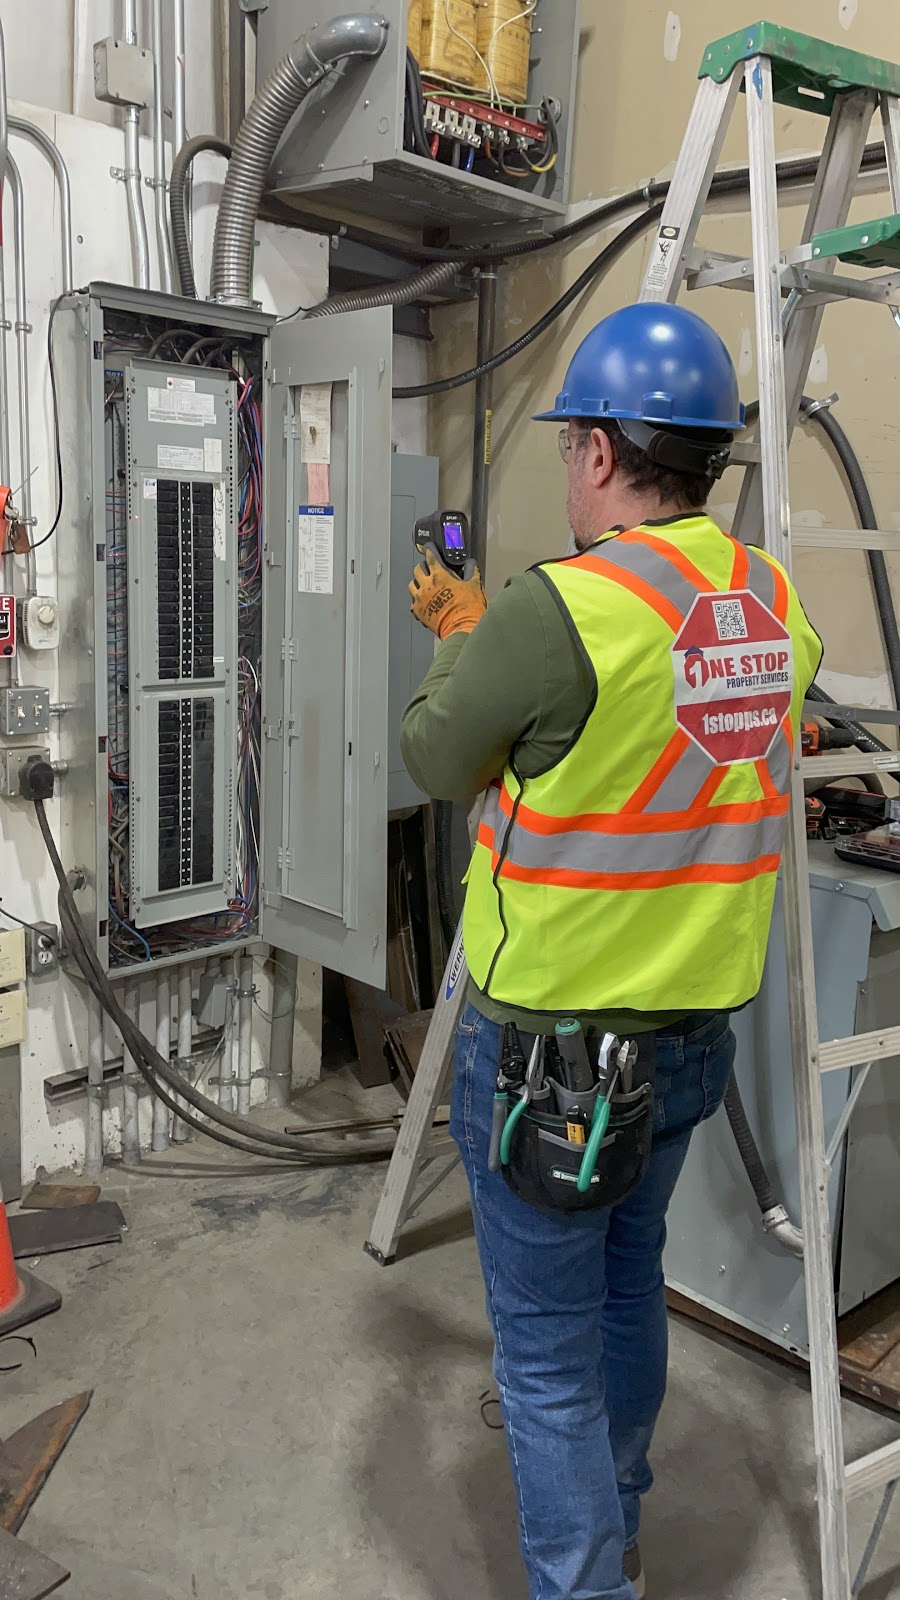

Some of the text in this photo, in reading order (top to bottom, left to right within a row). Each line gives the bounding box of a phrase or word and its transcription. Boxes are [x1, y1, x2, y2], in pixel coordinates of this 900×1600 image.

[2, 598, 10, 610] E
[427, 588, 452, 618] GRIP
[740, 652, 788, 675] STOP
[727, 674, 760, 689] PROPERTY
[760, 672, 789, 685] SERVICES
[702, 707, 778, 735] 1stopps.ca
